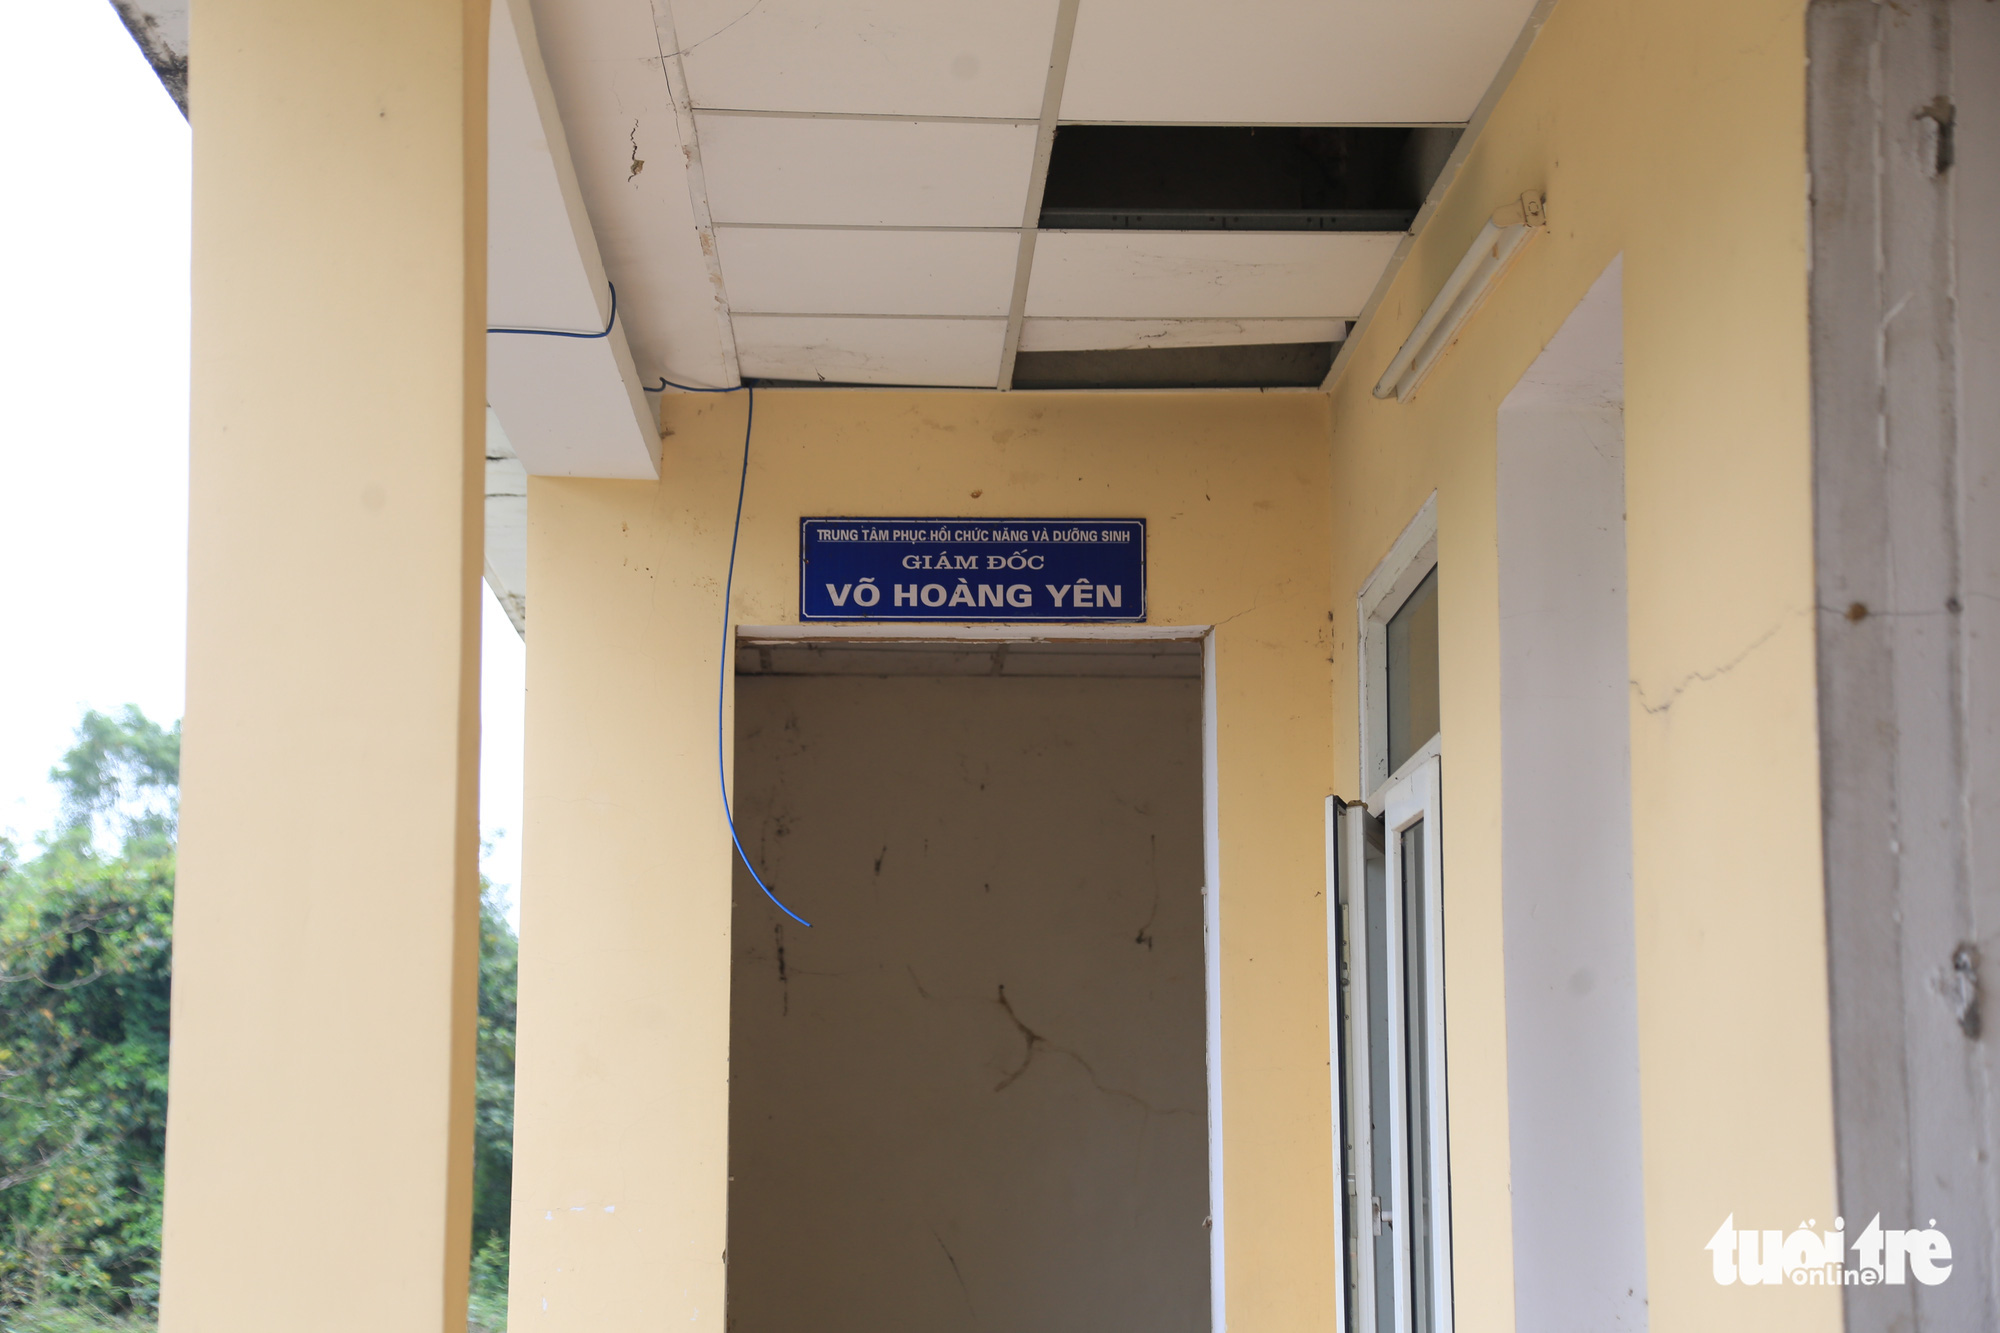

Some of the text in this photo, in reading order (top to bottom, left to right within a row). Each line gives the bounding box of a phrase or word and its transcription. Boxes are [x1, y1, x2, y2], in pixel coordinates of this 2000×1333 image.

[817, 525, 1130, 545] TRUNG TÂM PHỤC HỒI CHỨC NĂNG VÀ DƯỠNG SINH
[902, 549, 1045, 570] GIÁM ĐỐC
[825, 577, 1122, 608] VÕ HOÀNG YÊN
